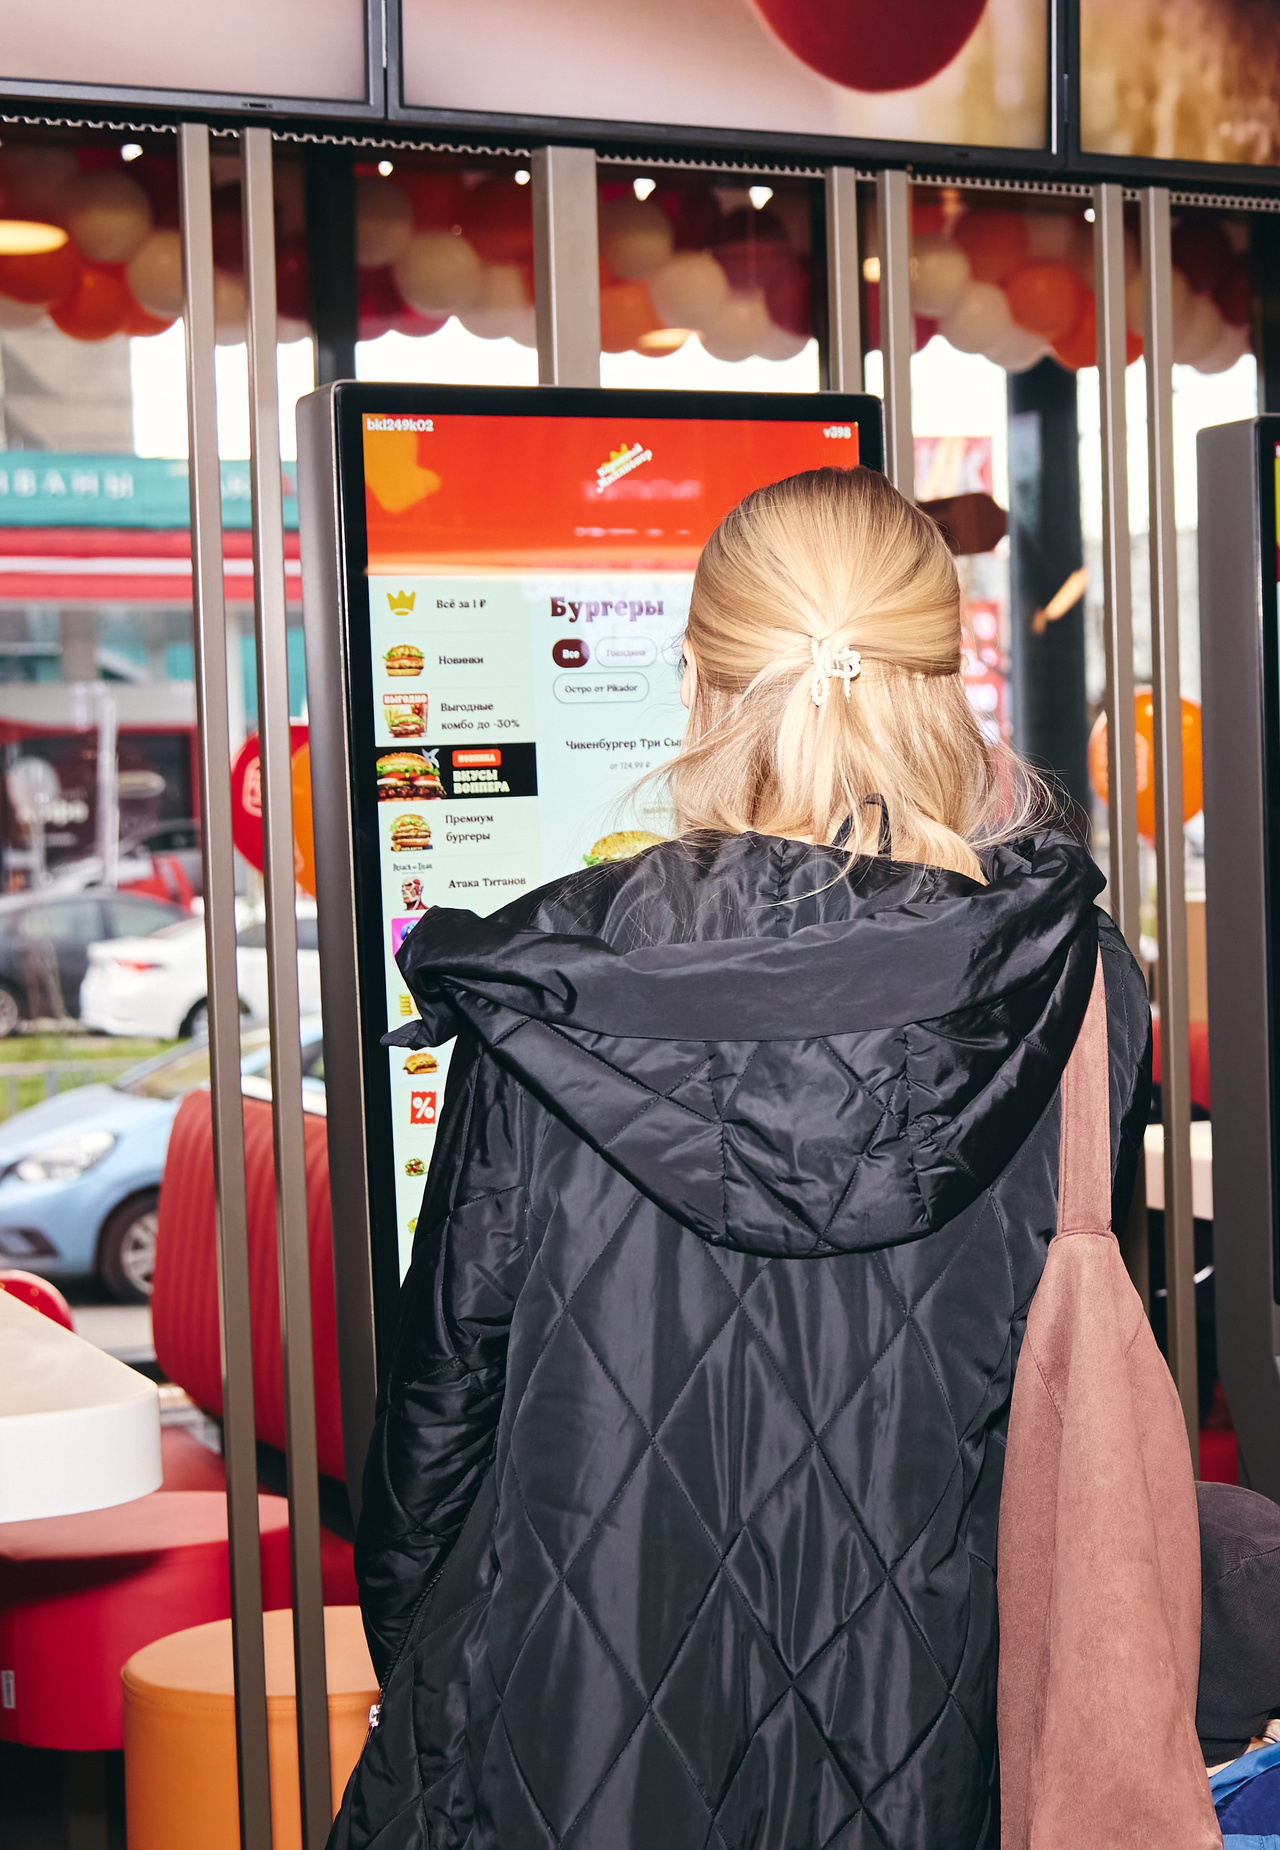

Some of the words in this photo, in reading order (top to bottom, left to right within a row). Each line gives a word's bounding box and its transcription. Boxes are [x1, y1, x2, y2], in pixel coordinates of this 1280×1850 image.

[823, 426, 851, 439] v398
[436, 599, 455, 608] Всё
[550, 597, 664, 622] Бургеры
[562, 649, 580, 659] Все
[438, 656, 484, 665] Новинки
[565, 684, 592, 694] Остро
[606, 683, 638, 692] Pikador
[440, 703, 494, 712] Выгодные
[441, 719, 474, 730] комбо
[477, 722, 490, 730] до
[493, 719, 520, 729] -30%
[566, 739, 636, 750] Чикенбургер
[640, 738, 661, 750] Три
[453, 769, 498, 782] ВКУСЫ
[453, 781, 510, 794] ВОППЕРА
[445, 814, 494, 825] Премиум
[446, 832, 490, 843] бургеры
[448, 879, 479, 889] Атака
[482, 877, 526, 888] Титанов
